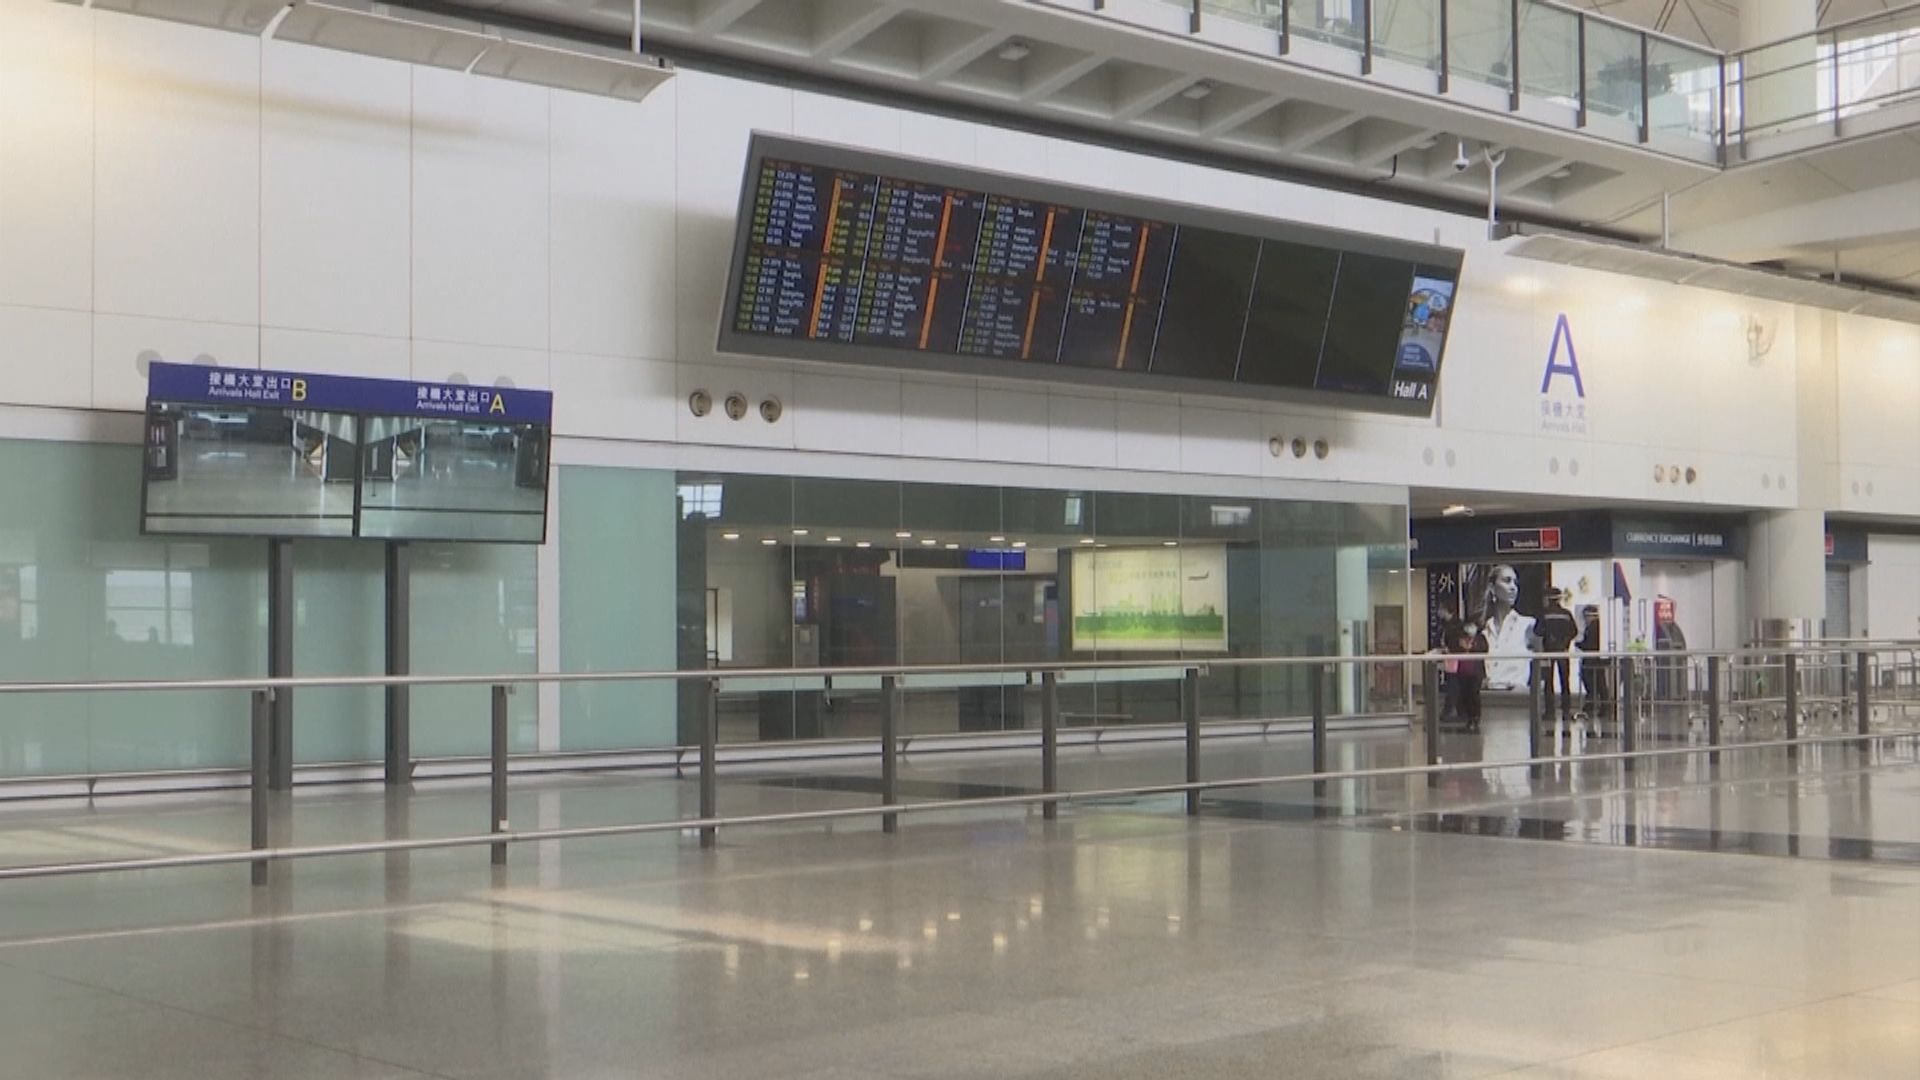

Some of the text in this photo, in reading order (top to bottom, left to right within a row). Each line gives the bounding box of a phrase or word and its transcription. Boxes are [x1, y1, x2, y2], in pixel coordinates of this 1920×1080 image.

[1541, 313, 1585, 398] A
[208, 386, 280, 400] Arrivals Hall Exit
[293, 378, 307, 401] B
[1394, 380, 1428, 400] Hall A
[416, 399, 480, 413] Arrivals Hall Exit
[489, 393, 506, 415] A
